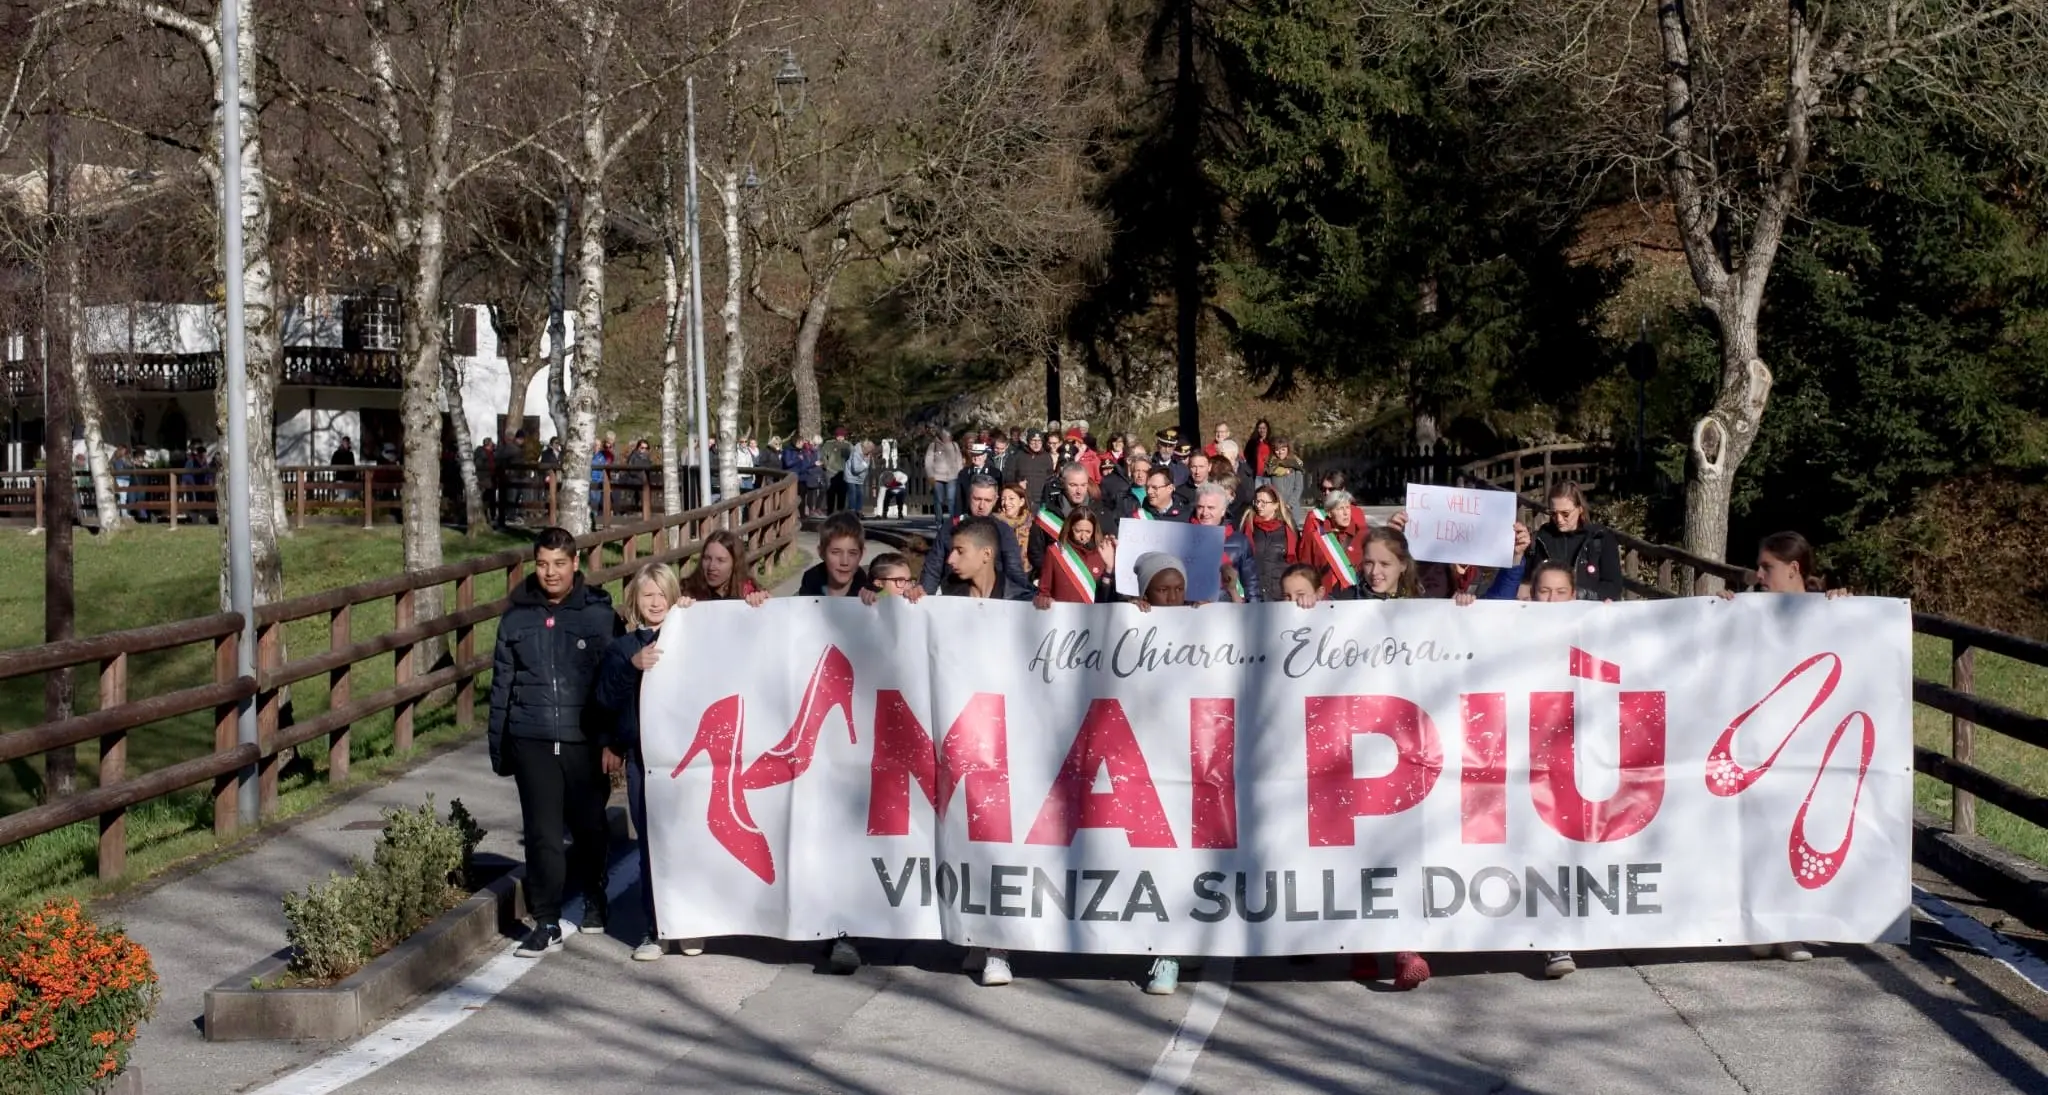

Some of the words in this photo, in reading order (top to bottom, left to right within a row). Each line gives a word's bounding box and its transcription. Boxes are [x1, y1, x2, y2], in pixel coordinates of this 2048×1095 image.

[1446, 494, 1481, 516] VALLE
[1028, 627, 1101, 684] Alba
[1111, 625, 1266, 679] Chiara...
[1280, 625, 1474, 679] Eleonora...
[867, 689, 1238, 849] MAI
[1305, 646, 1667, 848] PIÙ
[871, 857, 1170, 922] VIOLENZA
[1189, 867, 1399, 923] SULLE
[1422, 863, 1662, 918] DONNE
